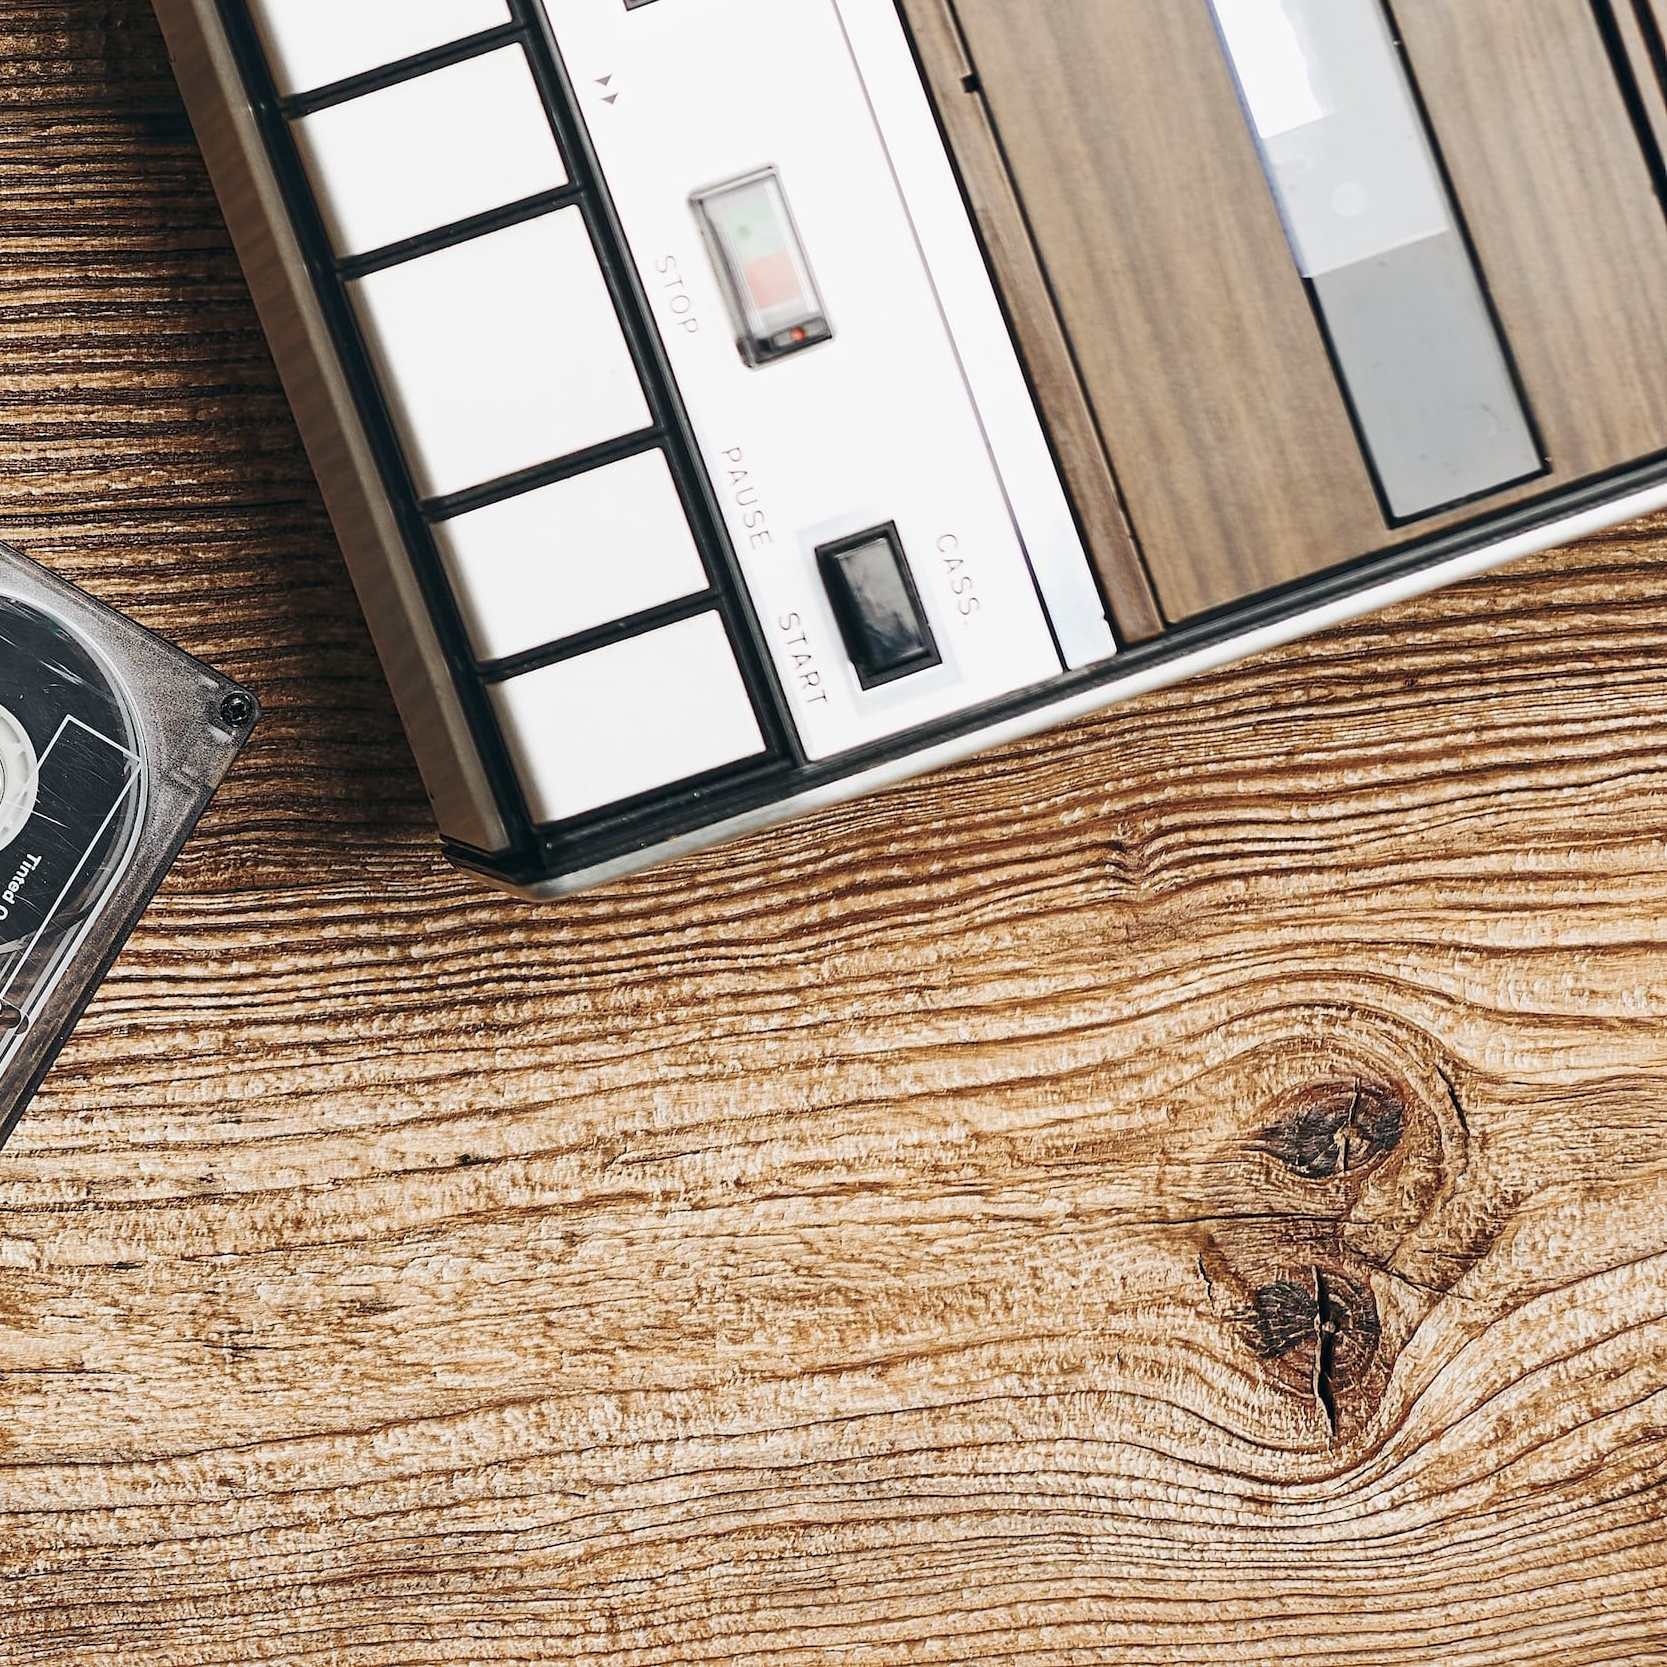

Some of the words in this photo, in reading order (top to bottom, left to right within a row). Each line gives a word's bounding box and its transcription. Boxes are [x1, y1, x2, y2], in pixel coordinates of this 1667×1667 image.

[655, 255, 699, 336] STOP
[721, 446, 772, 551] PAUSE
[778, 611, 828, 707] START
[1, 852, 42, 905] Tinted
